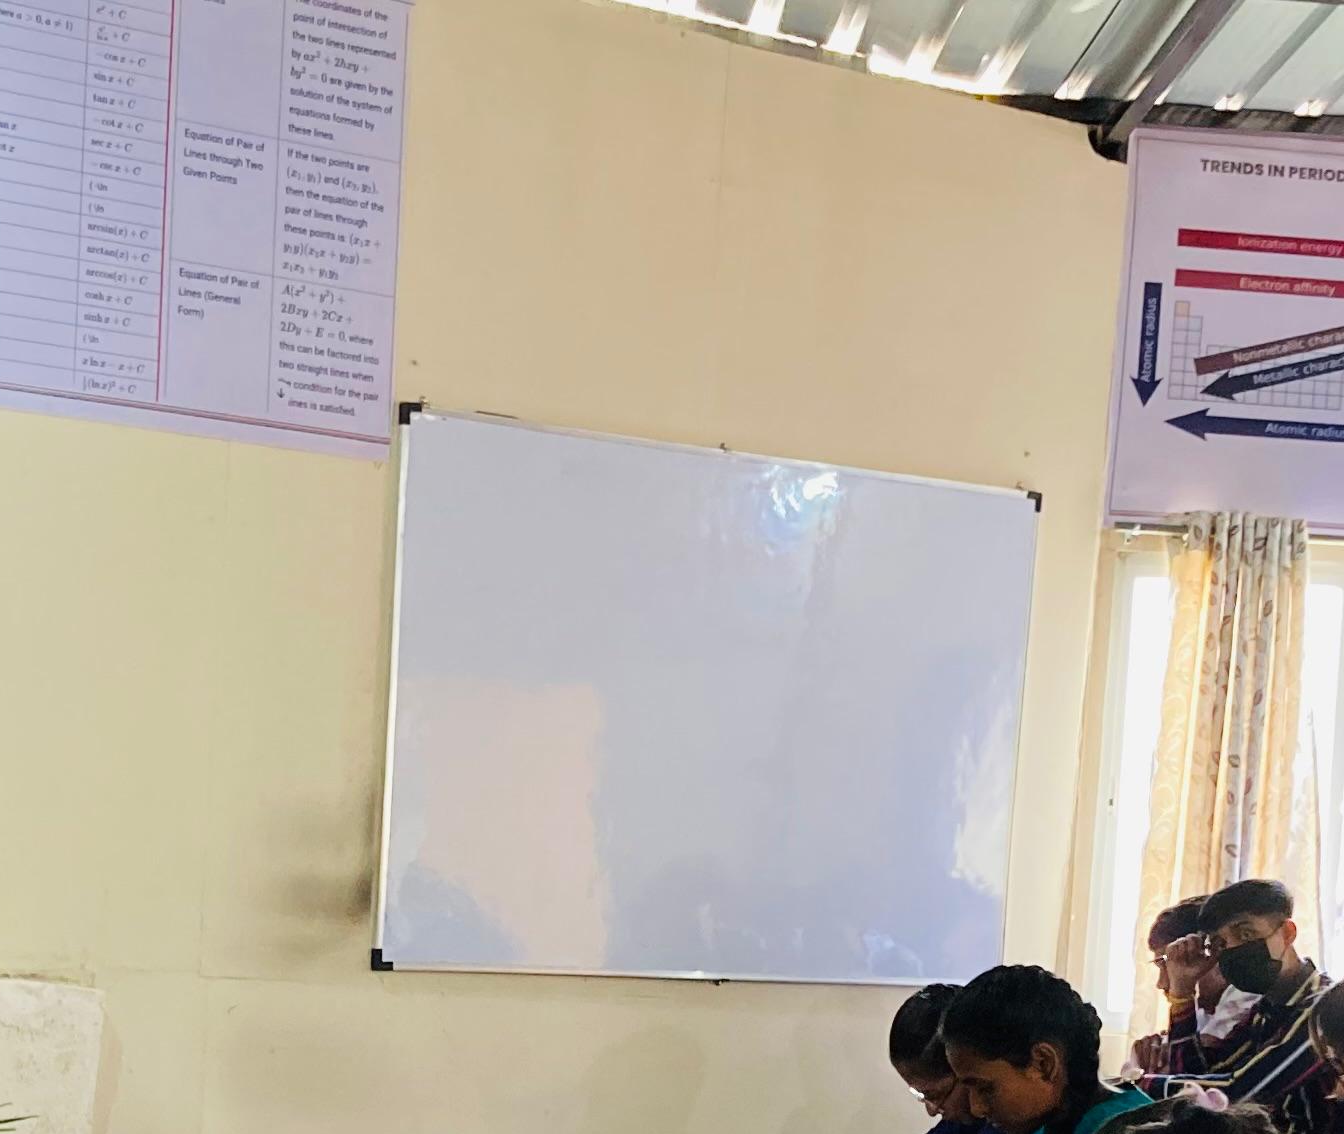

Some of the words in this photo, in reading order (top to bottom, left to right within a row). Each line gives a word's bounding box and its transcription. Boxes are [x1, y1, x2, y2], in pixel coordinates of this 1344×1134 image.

[364, 9, 373, 18] of
[374, 11, 388, 21] the
[293, 13, 314, 26] point
[317, 18, 326, 27] of
[328, 20, 376, 39] intersection
[379, 30, 388, 40] of
[292, 49, 301, 62] by
[293, 30, 306, 42] the
[308, 34, 324, 46] two
[326, 37, 345, 49] lines
[347, 42, 397, 61] represented
[330, 76, 342, 86] are
[345, 79, 366, 91] given
[369, 84, 378, 95] by
[380, 86, 393, 97] the
[290, 87, 324, 102] solution
[326, 93, 335, 103] of
[337, 95, 349, 107] the
[352, 99, 381, 114] system
[384, 106, 393, 115] of
[289, 106, 330, 122] equations
[333, 113, 363, 128] formed
[365, 119, 374, 131] by
[184, 128, 223, 146] Equation
[225, 136, 234, 146] of
[237, 138, 253, 150] Pair
[256, 143, 264, 152] of
[288, 123, 311, 136] these
[184, 148, 207, 161] Lines
[209, 153, 243, 168] through
[245, 159, 263, 171] Two
[287, 148, 294, 159] If
[295, 150, 308, 161] the
[311, 153, 326, 164] two
[328, 157, 355, 172] points
[357, 163, 370, 173] are
[1201, 159, 1264, 176] TRENDS
[1268, 163, 1285, 178] IN
[183, 167, 207, 179] Given
[210, 171, 238, 185] Points
[324, 176, 340, 187] and
[286, 185, 304, 198] then
[306, 188, 320, 201] the
[322, 192, 358, 208] equation
[360, 199, 369, 209] of
[371, 201, 384, 213] the
[285, 205, 301, 218] pair
[303, 208, 312, 218] of
[314, 210, 333, 223] lines
[336, 213, 368, 229] through
[284, 223, 307, 236] these
[309, 227, 335, 241] points
[1238, 236, 1297, 251] Ionization
[1300, 241, 1343, 256] energy
[179, 267, 218, 283] Equation
[220, 274, 229, 285] of
[231, 276, 248, 288] Pair
[250, 279, 260, 289] of
[1240, 277, 1290, 293] Electron
[1294, 282, 1335, 298] affinity
[178, 287, 201, 300] Lines
[204, 291, 241, 306] (General
[178, 305, 204, 319] Form)
[1145, 298, 1157, 342] radius
[349, 335, 374, 346] where
[1233, 337, 1307, 363] Nonmetallic
[279, 341, 296, 352] this
[297, 345, 313, 355] can
[314, 346, 325, 356] be
[327, 348, 361, 362] factored
[363, 354, 379, 365] into
[1140, 343, 1151, 382] Atomic
[279, 359, 295, 371] two
[297, 362, 328, 377] straight
[330, 367, 349, 379] lines
[352, 371, 374, 382] when
[1254, 365, 1300, 385] Metallic
[293, 381, 332, 395] condition
[334, 384, 347, 396] for
[348, 387, 361, 399] the
[363, 390, 379, 401] pair
[310, 402, 317, 411] is
[1265, 422, 1307, 437] Atomic
